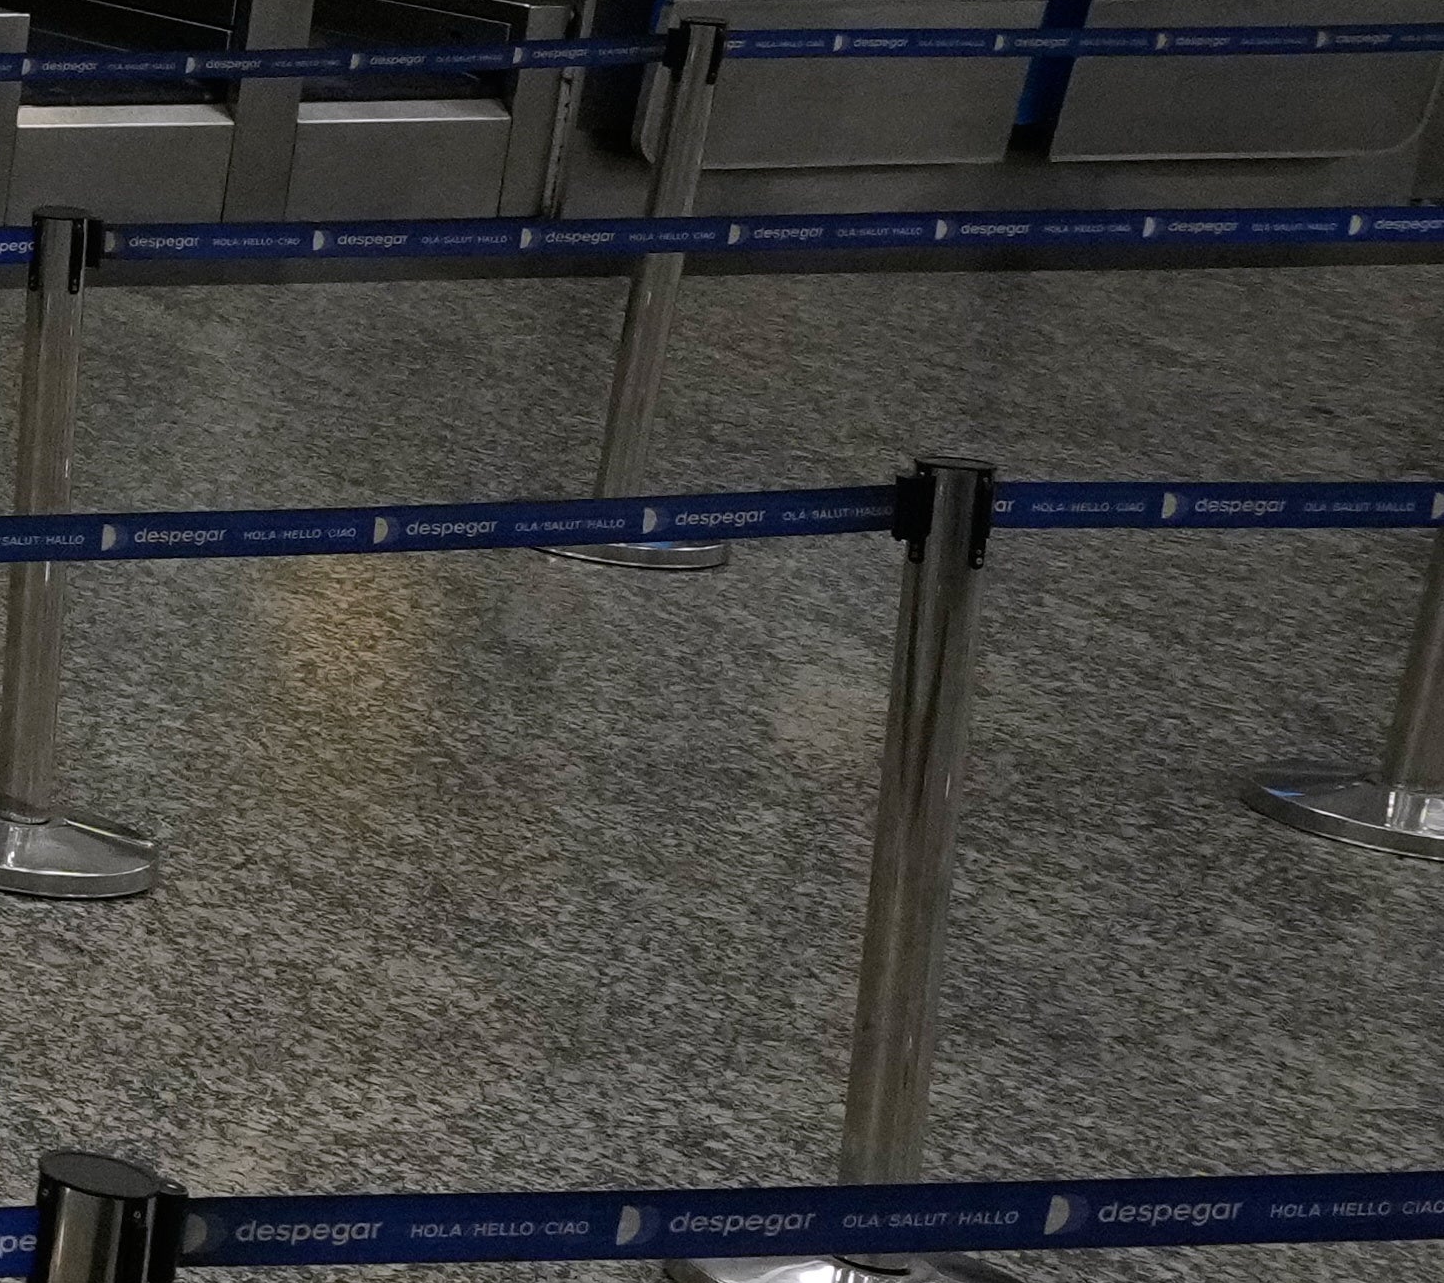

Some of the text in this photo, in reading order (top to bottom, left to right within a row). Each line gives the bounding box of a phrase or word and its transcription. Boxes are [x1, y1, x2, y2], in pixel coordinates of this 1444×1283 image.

[130, 228, 823, 250] despegar despegar despegar despegar
[1195, 498, 1285, 516] despegar
[135, 528, 226, 545] despegar
[407, 521, 497, 538] despegar
[676, 511, 765, 527] despegar
[235, 1220, 383, 1246] despegar
[669, 1211, 816, 1237] despegar
[1098, 1201, 1243, 1227] despegar
